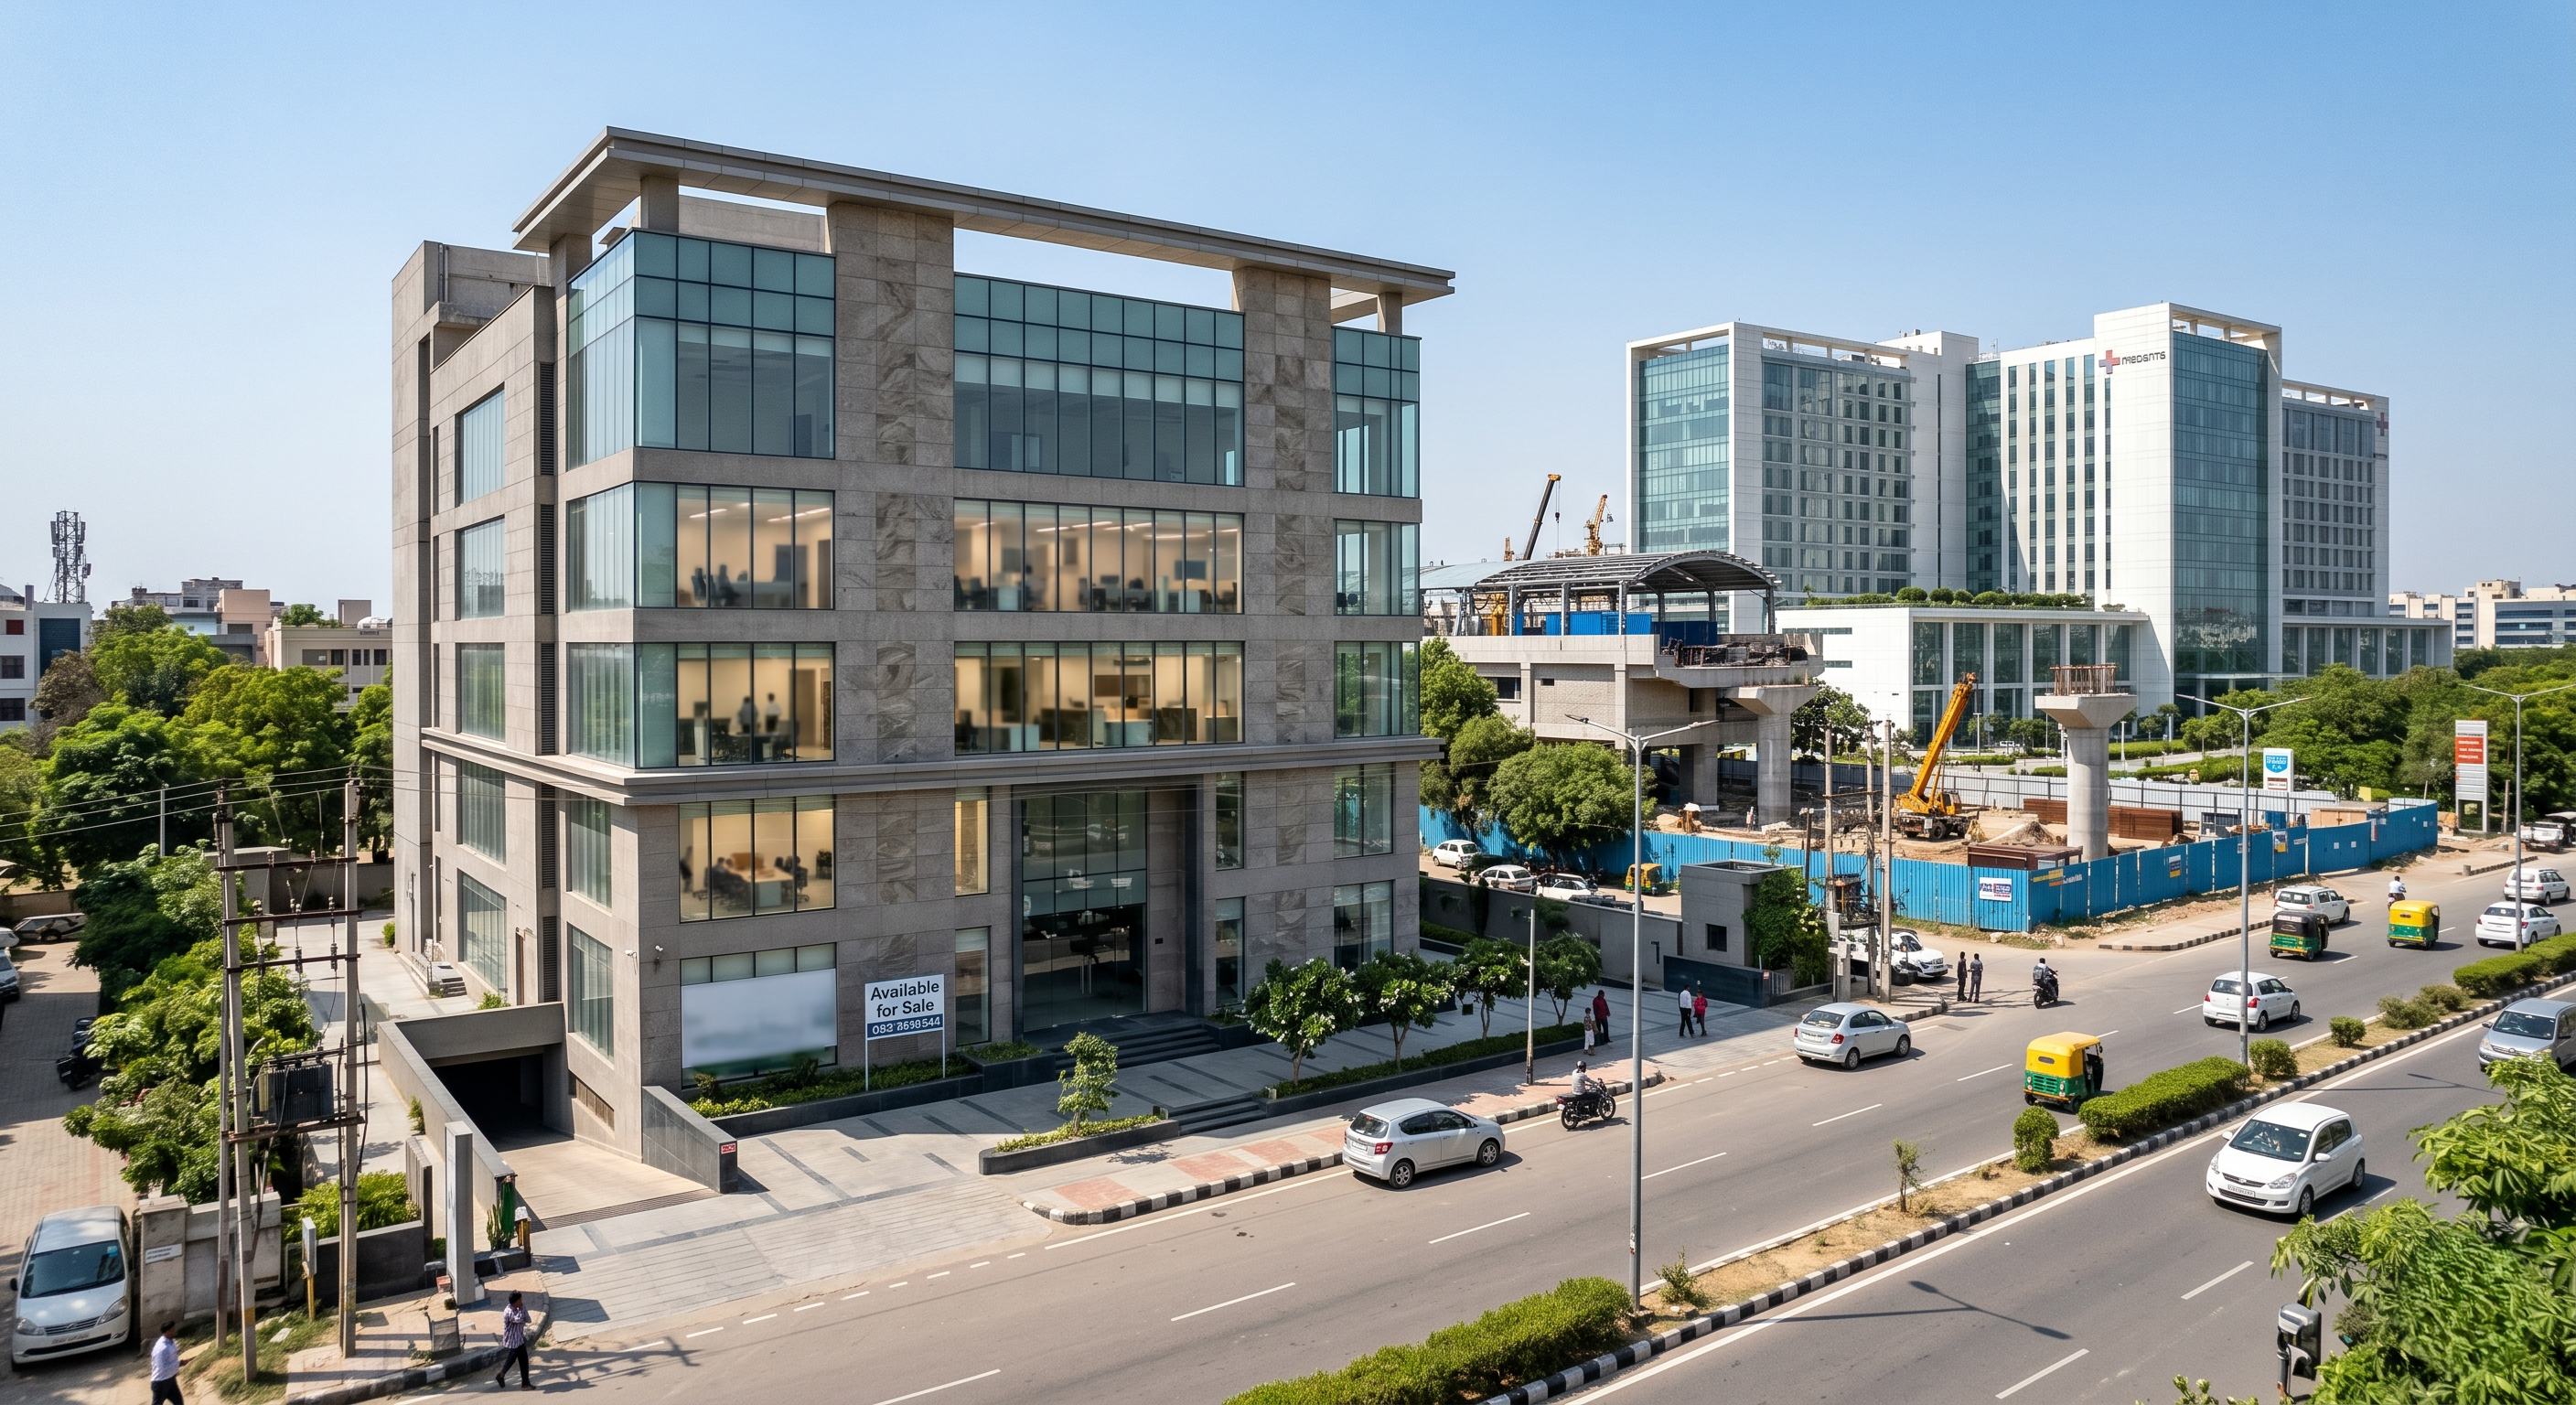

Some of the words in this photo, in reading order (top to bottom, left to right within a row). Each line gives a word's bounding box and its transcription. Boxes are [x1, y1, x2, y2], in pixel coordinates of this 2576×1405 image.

[870, 980, 939, 1001] Available
[876, 1003, 898, 1018] for
[902, 998, 935, 1014] Sale
